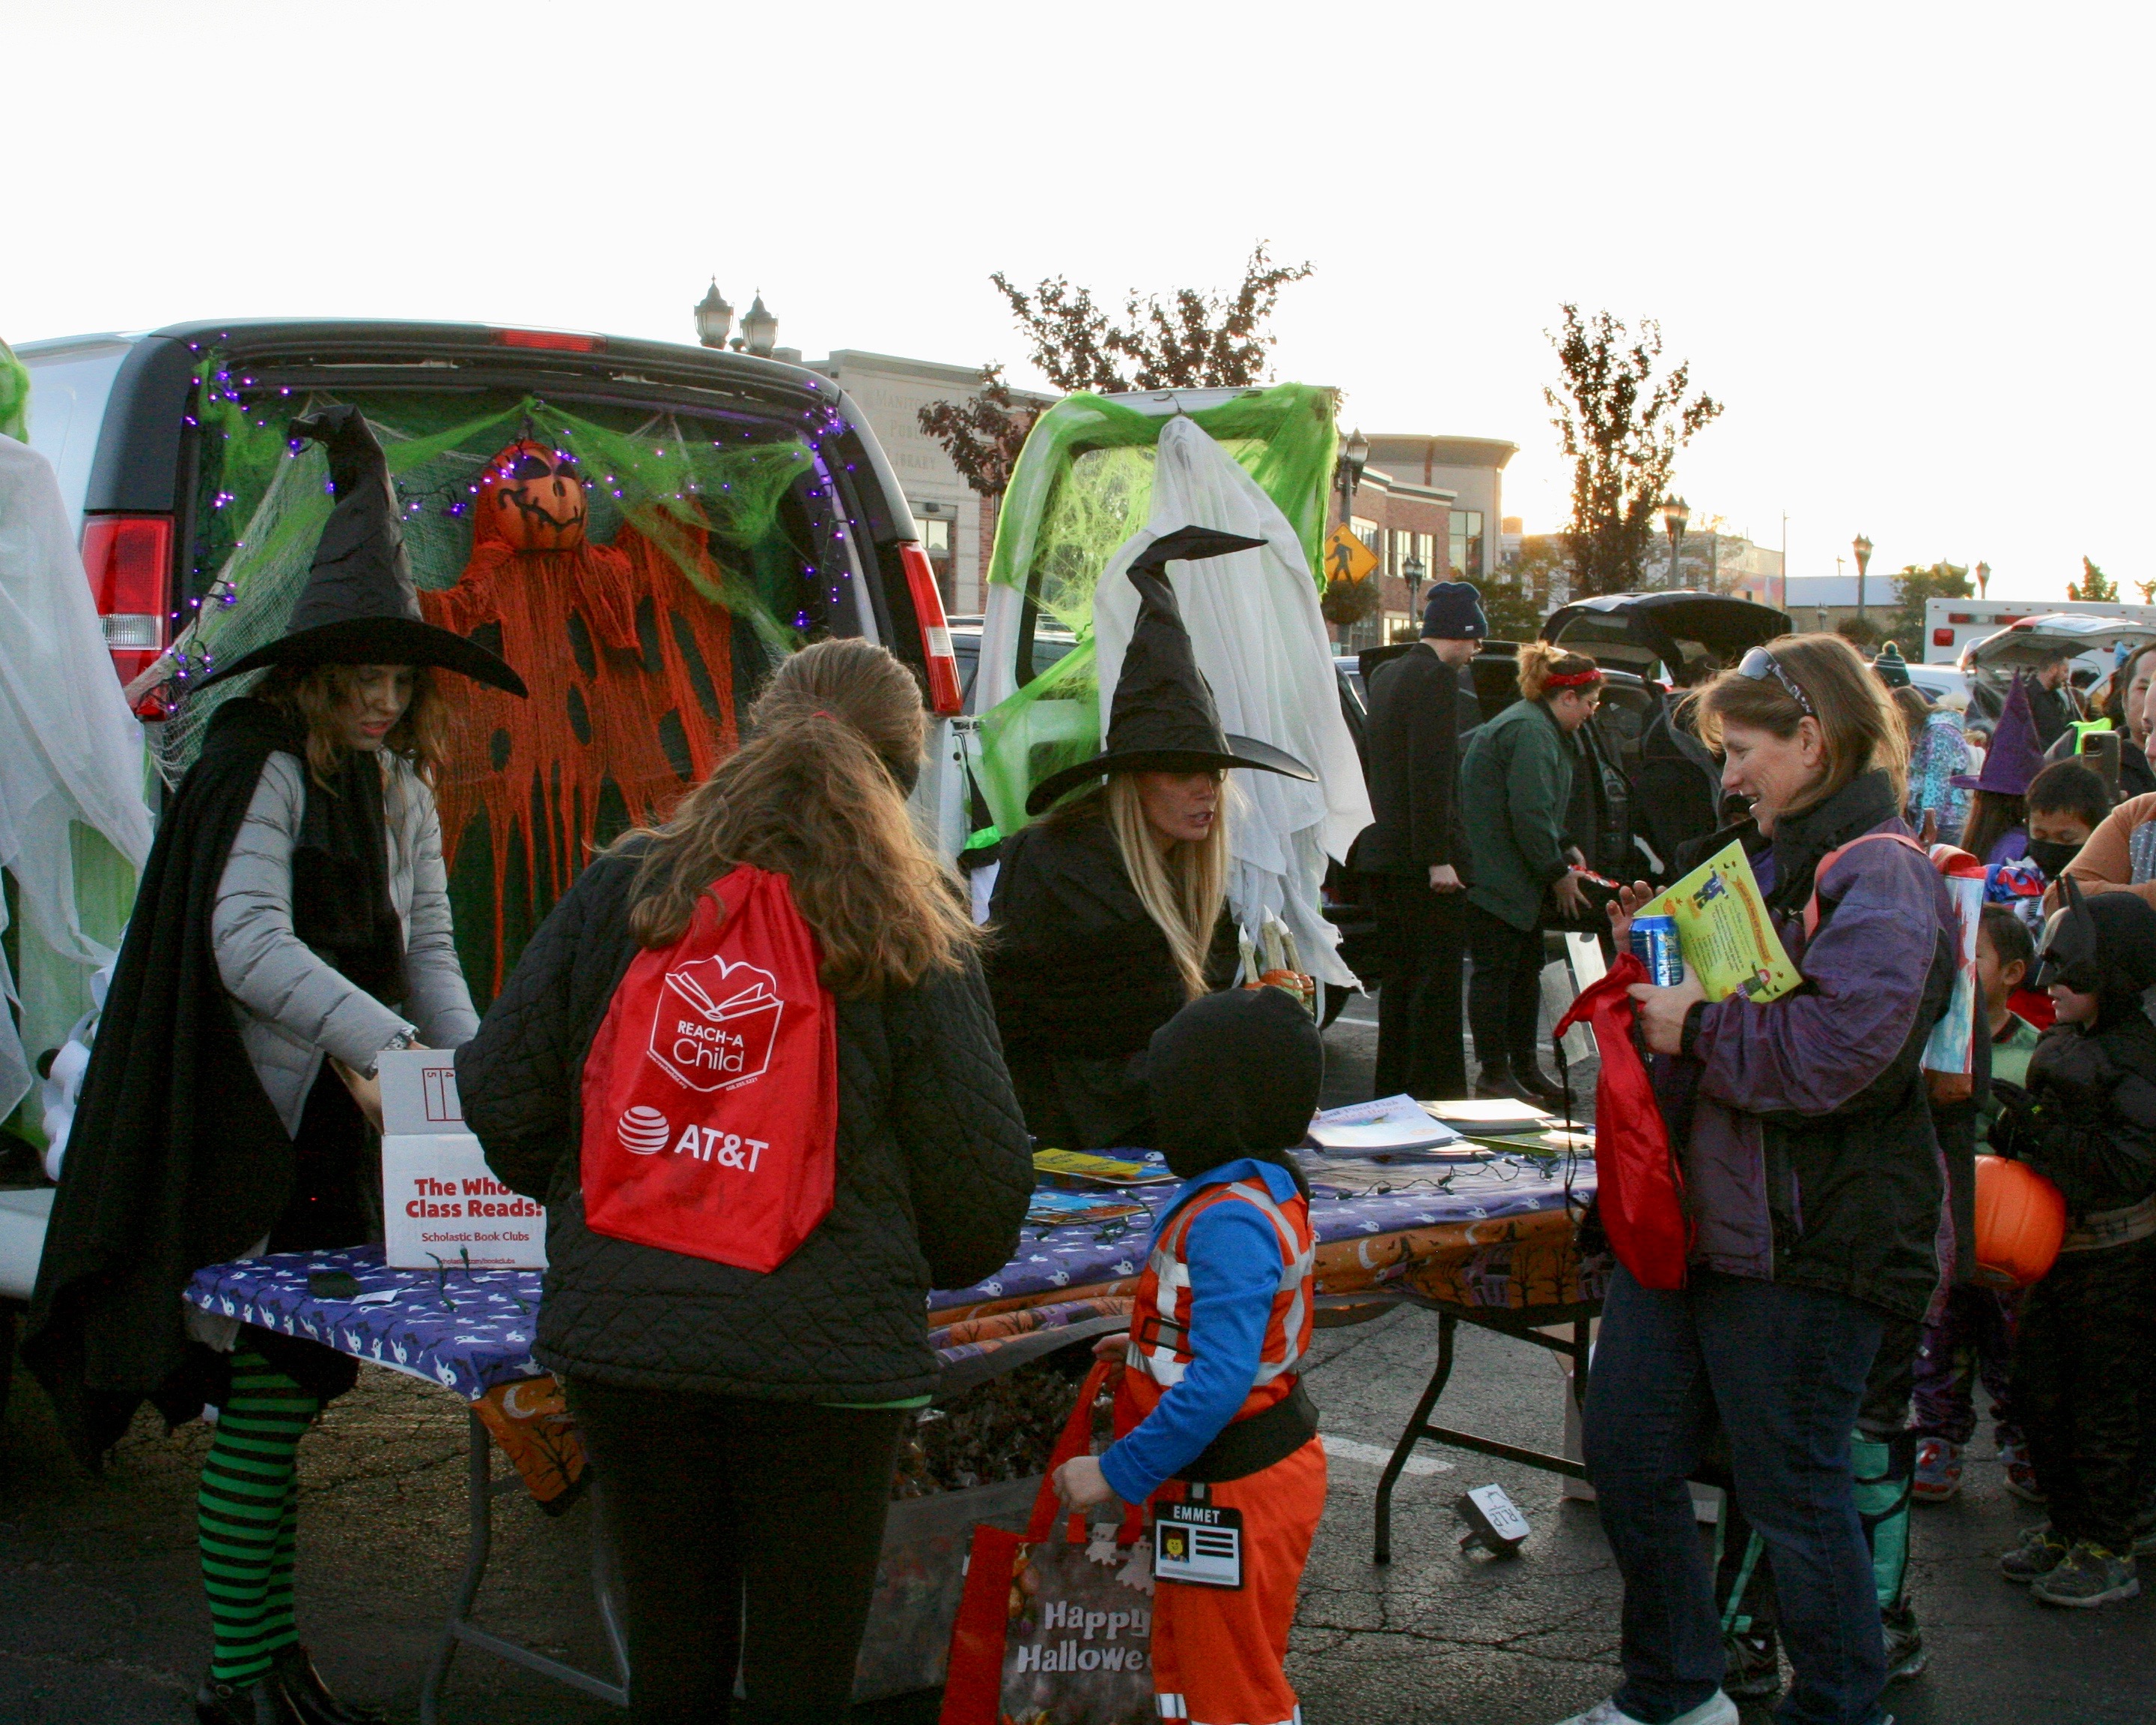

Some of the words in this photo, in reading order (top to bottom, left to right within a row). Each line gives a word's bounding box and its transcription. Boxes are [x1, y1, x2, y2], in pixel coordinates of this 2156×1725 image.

[677, 1020, 744, 1047] REACH-A
[674, 1038, 745, 1072] Child
[674, 1124, 770, 1173] AT&T
[414, 1177, 457, 1196] The
[462, 1177, 518, 1196] Who
[406, 1199, 462, 1218] Class
[421, 1232, 472, 1242] Scholastic
[475, 1232, 499, 1241] Book
[502, 1232, 529, 1241] Clubs
[1173, 1505, 1220, 1524] EMMET
[1044, 1600, 1151, 1640] Happy
[1017, 1639, 1151, 1673] Hallowe
